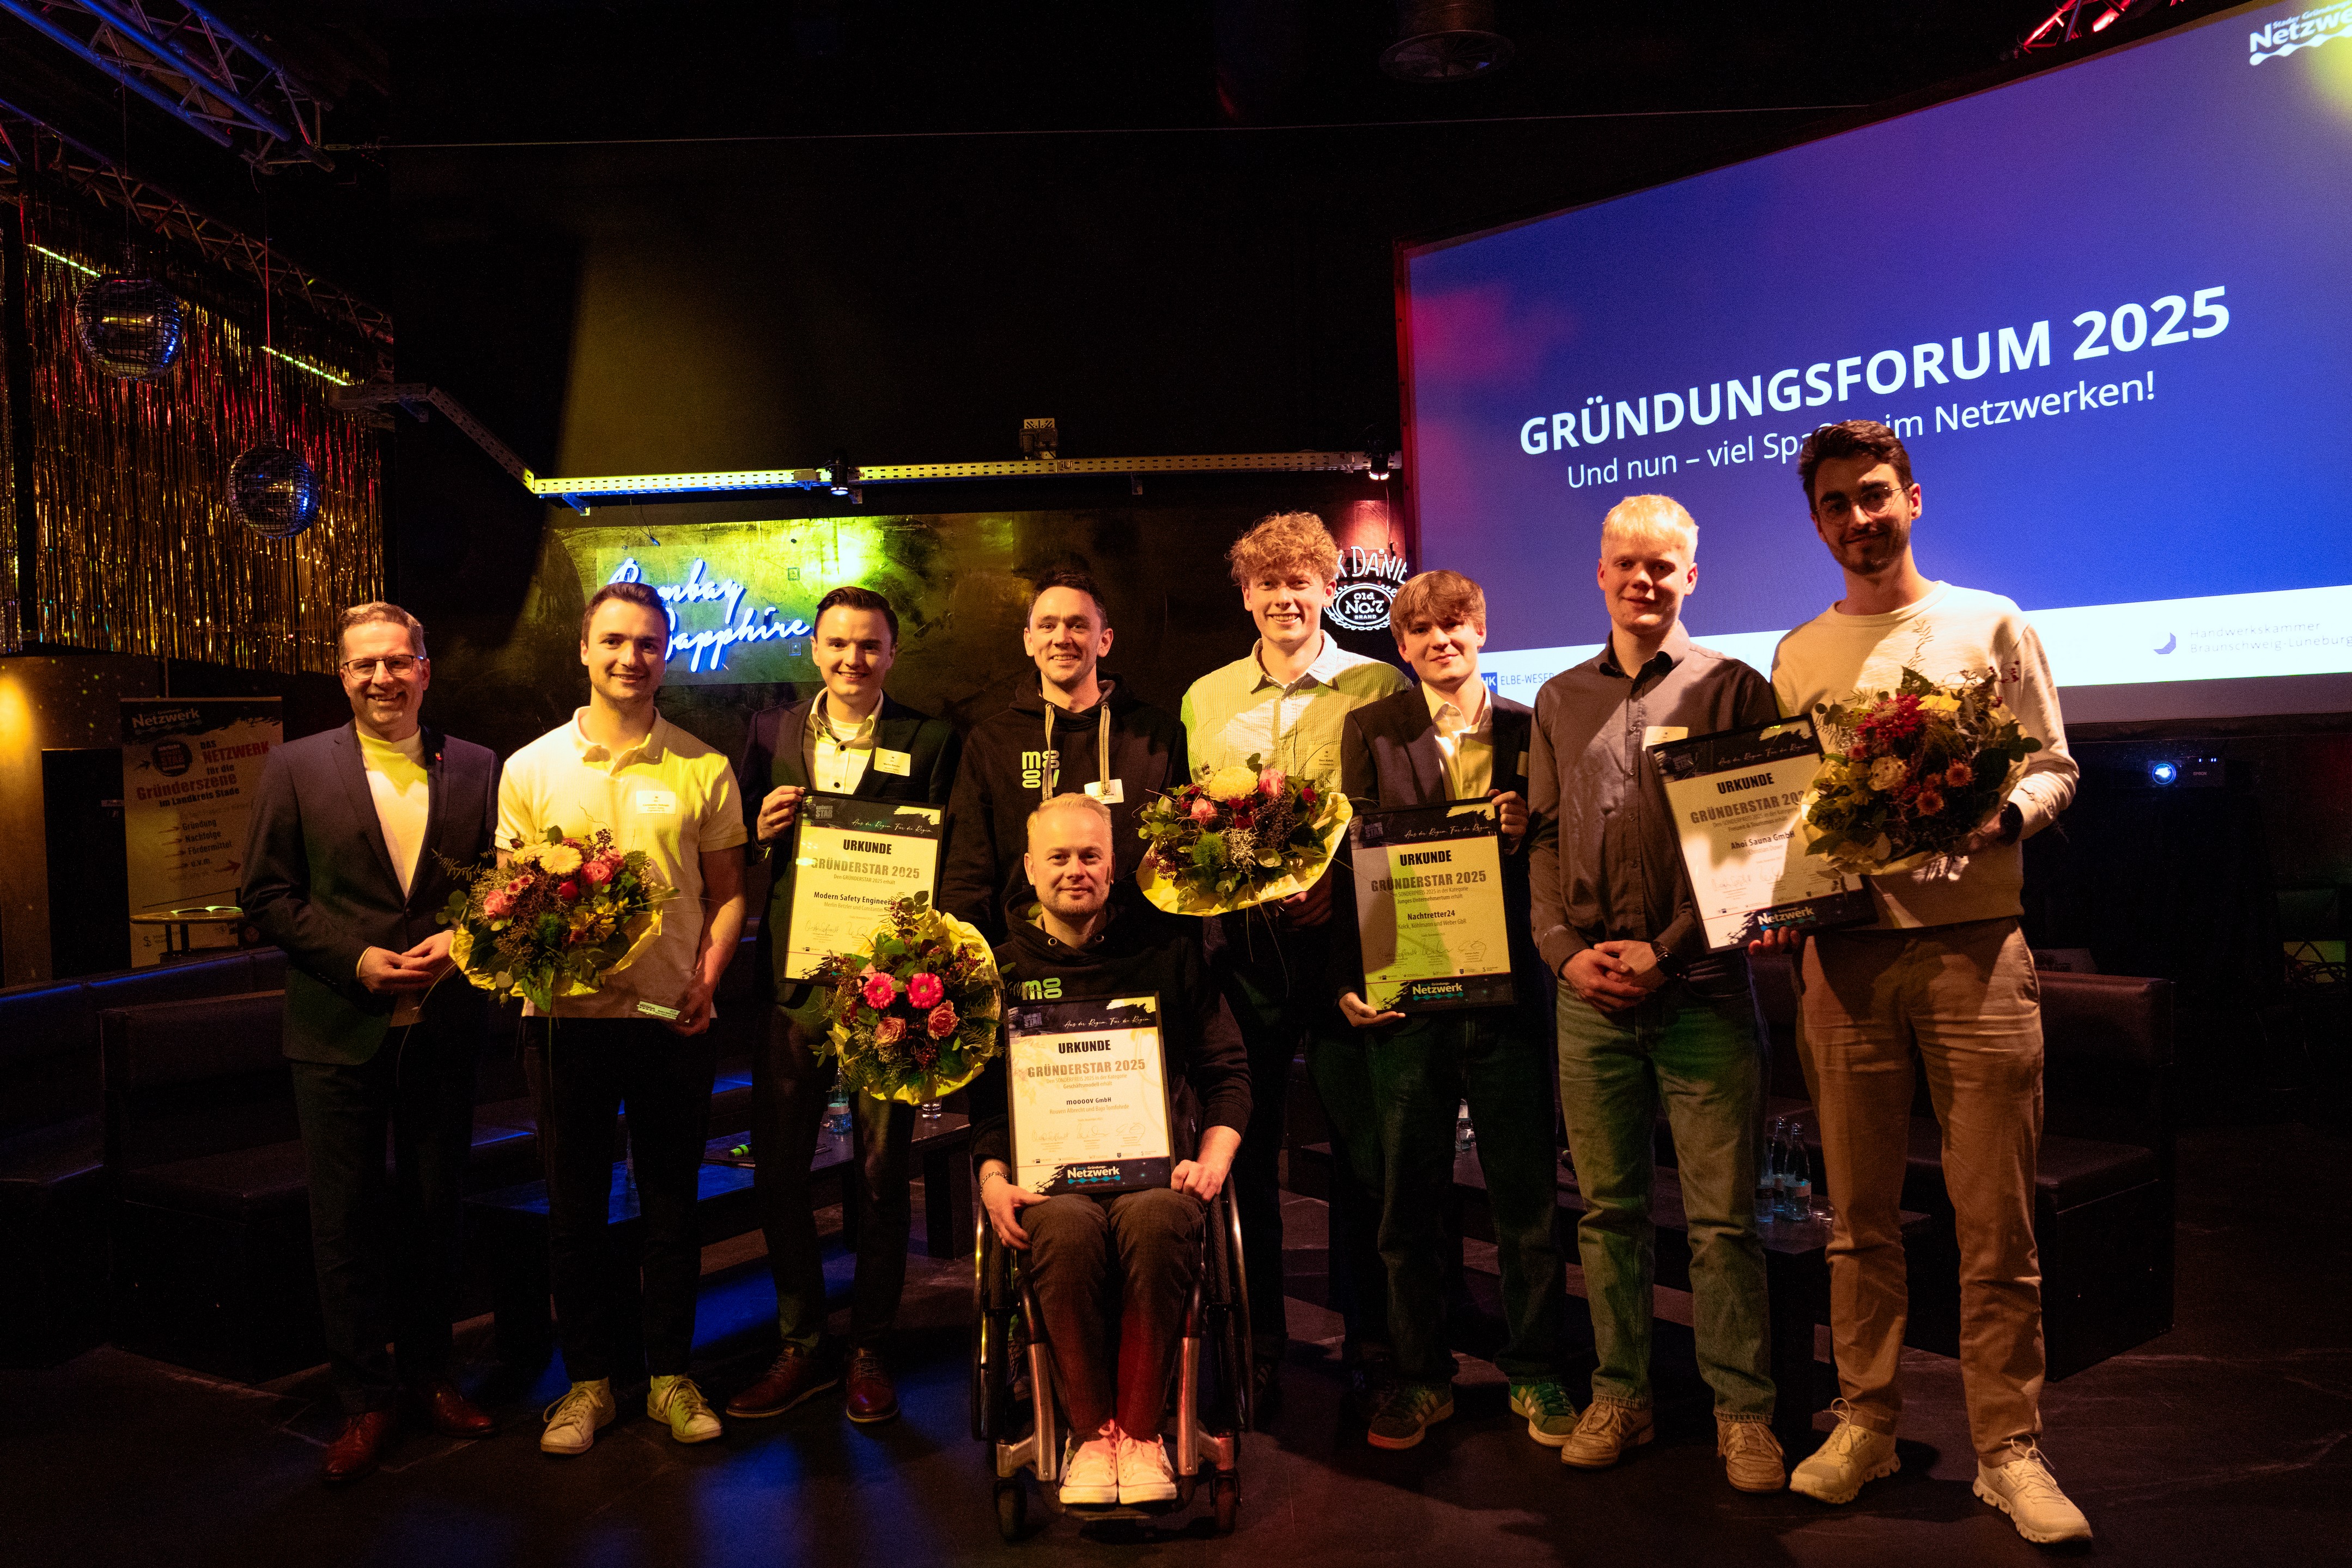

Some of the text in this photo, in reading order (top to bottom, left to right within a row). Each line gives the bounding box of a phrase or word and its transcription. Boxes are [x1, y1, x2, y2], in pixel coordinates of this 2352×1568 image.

[2250, 8, 2352, 53] Netzwe
[1520, 285, 2231, 454] GRÜNDUNGSFORUM 2025
[1568, 458, 1618, 489] Und
[1627, 453, 1677, 481] nun
[1707, 435, 1753, 467] viel
[1935, 370, 2155, 434] Netzwerken!
[2190, 623, 2320, 638] Handwerkskammer
[1481, 676, 1497, 686] HK
[131, 708, 200, 728] Netzwerk
[200, 740, 217, 750] DAS
[202, 740, 270, 764] NETZWERK
[207, 764, 234, 775] für die
[136, 774, 238, 800] Gründerszene
[1716, 773, 1774, 794] URKUNDE
[159, 787, 240, 808] im Landkreis Stade
[815, 810, 832, 818] STAR
[1690, 790, 1804, 824] GRÜNDERSTAR 202
[183, 819, 217, 831] Gründung
[185, 831, 222, 843] Nachfolge
[1730, 830, 1795, 850] Ahoi Sauna GmbH
[188, 840, 233, 855] Fördermittel
[843, 839, 892, 855] URKUNDE
[1399, 850, 1452, 866] URKUNDE
[811, 858, 920, 879] GRÜNDERSTAR 2025
[842, 874, 872, 883] GRÜNDERSTAR
[1371, 870, 1486, 892] GRÜNDERSTAR 2025
[814, 891, 838, 900] Modern
[840, 894, 861, 905] Safety
[1398, 889, 1425, 897] SONDERPREIS
[1407, 910, 1456, 920] Nachtretter24
[1757, 906, 1814, 925] Netzwerk
[1412, 982, 1462, 995] Netzwerk
[1024, 1017, 1042, 1027] STAR
[1058, 1040, 1111, 1054] URKUNDE
[1028, 1059, 1145, 1078] GRÜNDERSTAR 2025
[1067, 1166, 1120, 1179] Netzwerk
